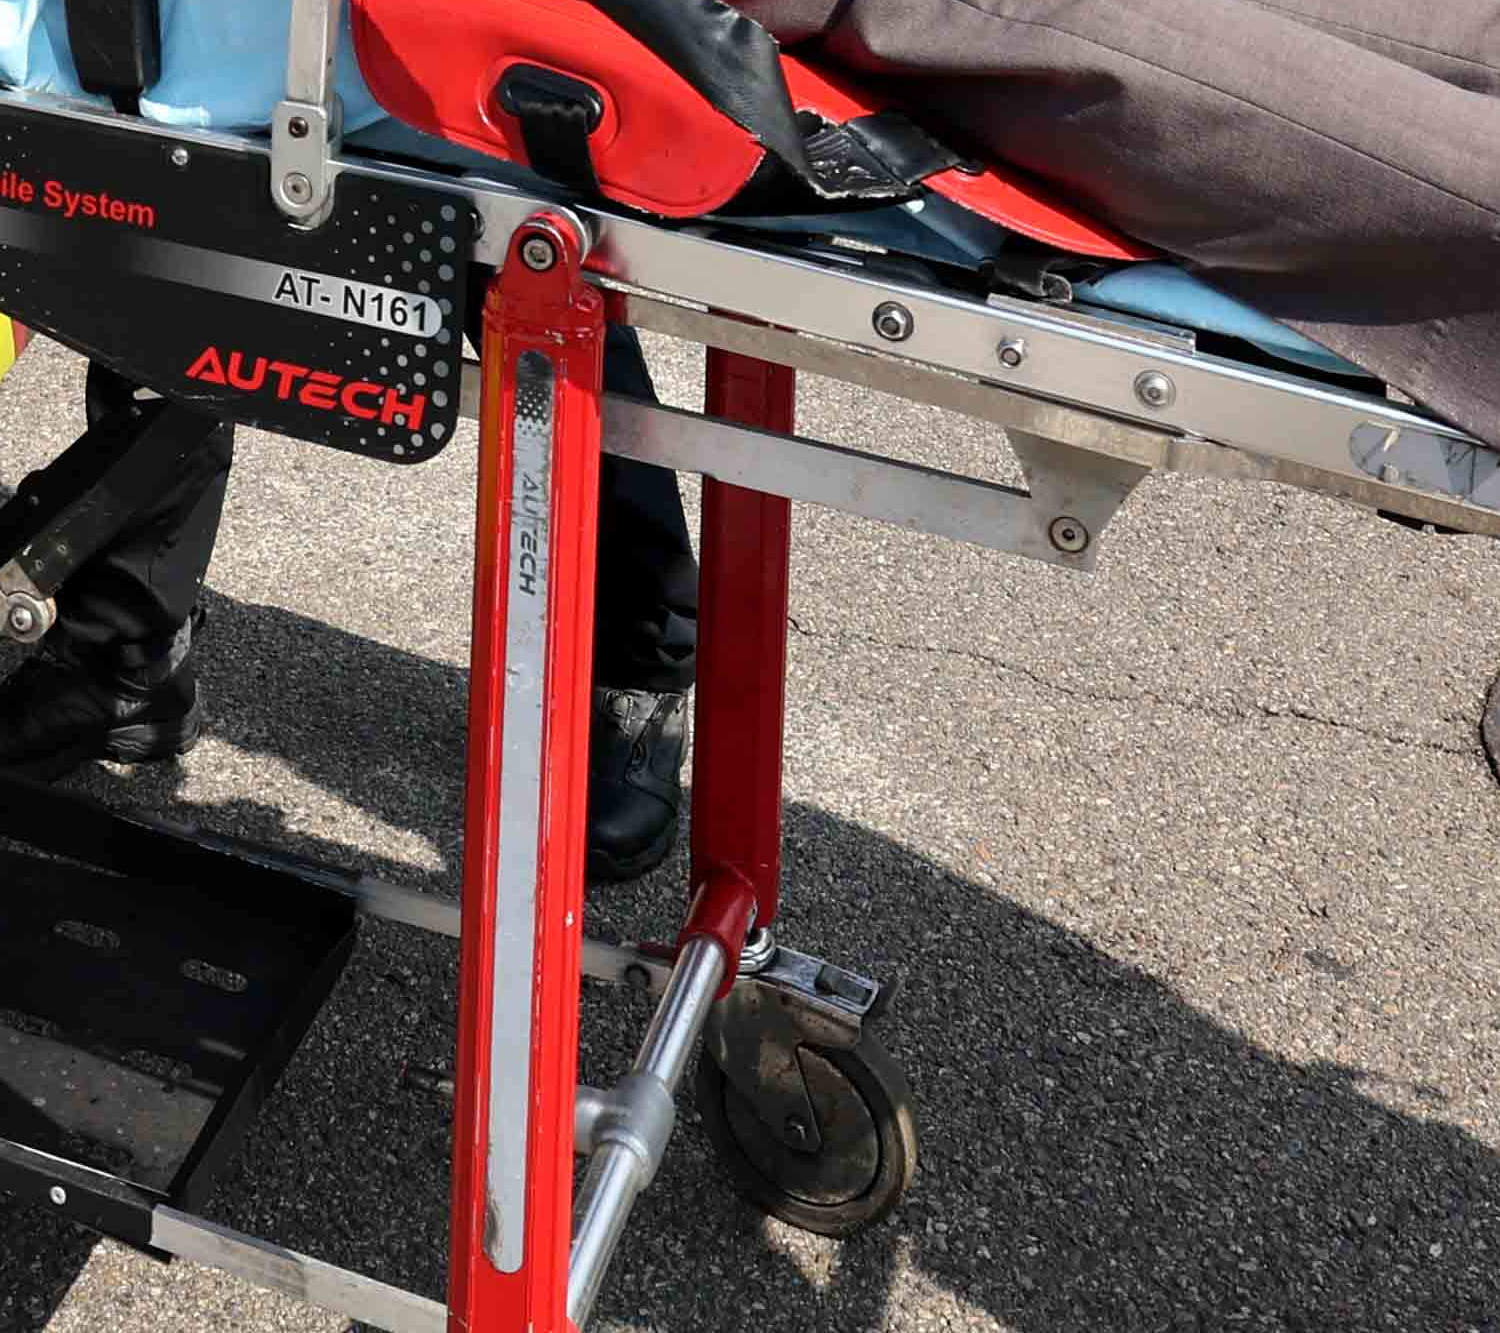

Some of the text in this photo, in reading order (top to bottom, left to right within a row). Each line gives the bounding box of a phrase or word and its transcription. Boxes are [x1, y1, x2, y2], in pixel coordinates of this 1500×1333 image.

[43, 180, 156, 230] System
[343, 288, 431, 334] N161
[186, 345, 426, 432] AUTECH
